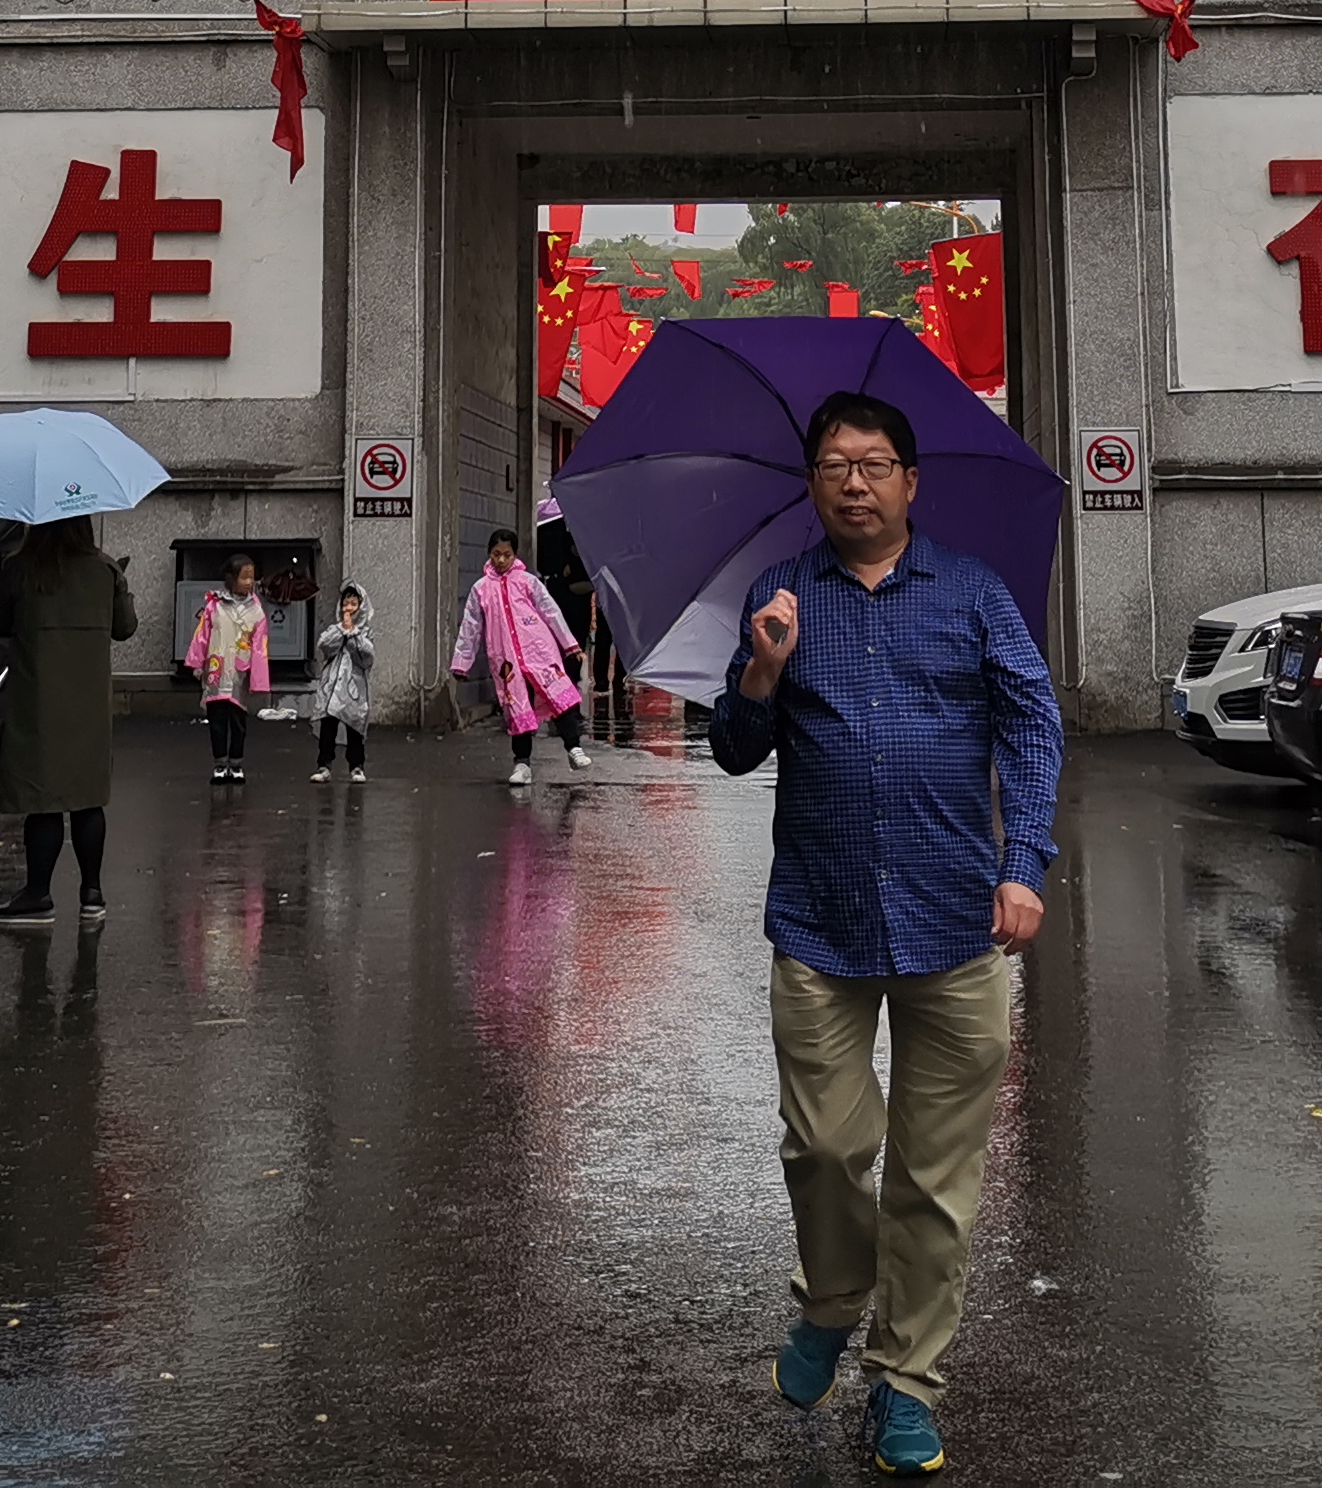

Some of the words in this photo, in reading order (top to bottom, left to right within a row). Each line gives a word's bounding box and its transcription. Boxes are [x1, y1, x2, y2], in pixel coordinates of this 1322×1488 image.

[356, 500, 411, 515] 禁止车辆驶入
[1084, 493, 1143, 509] 禁止车辆驶入
